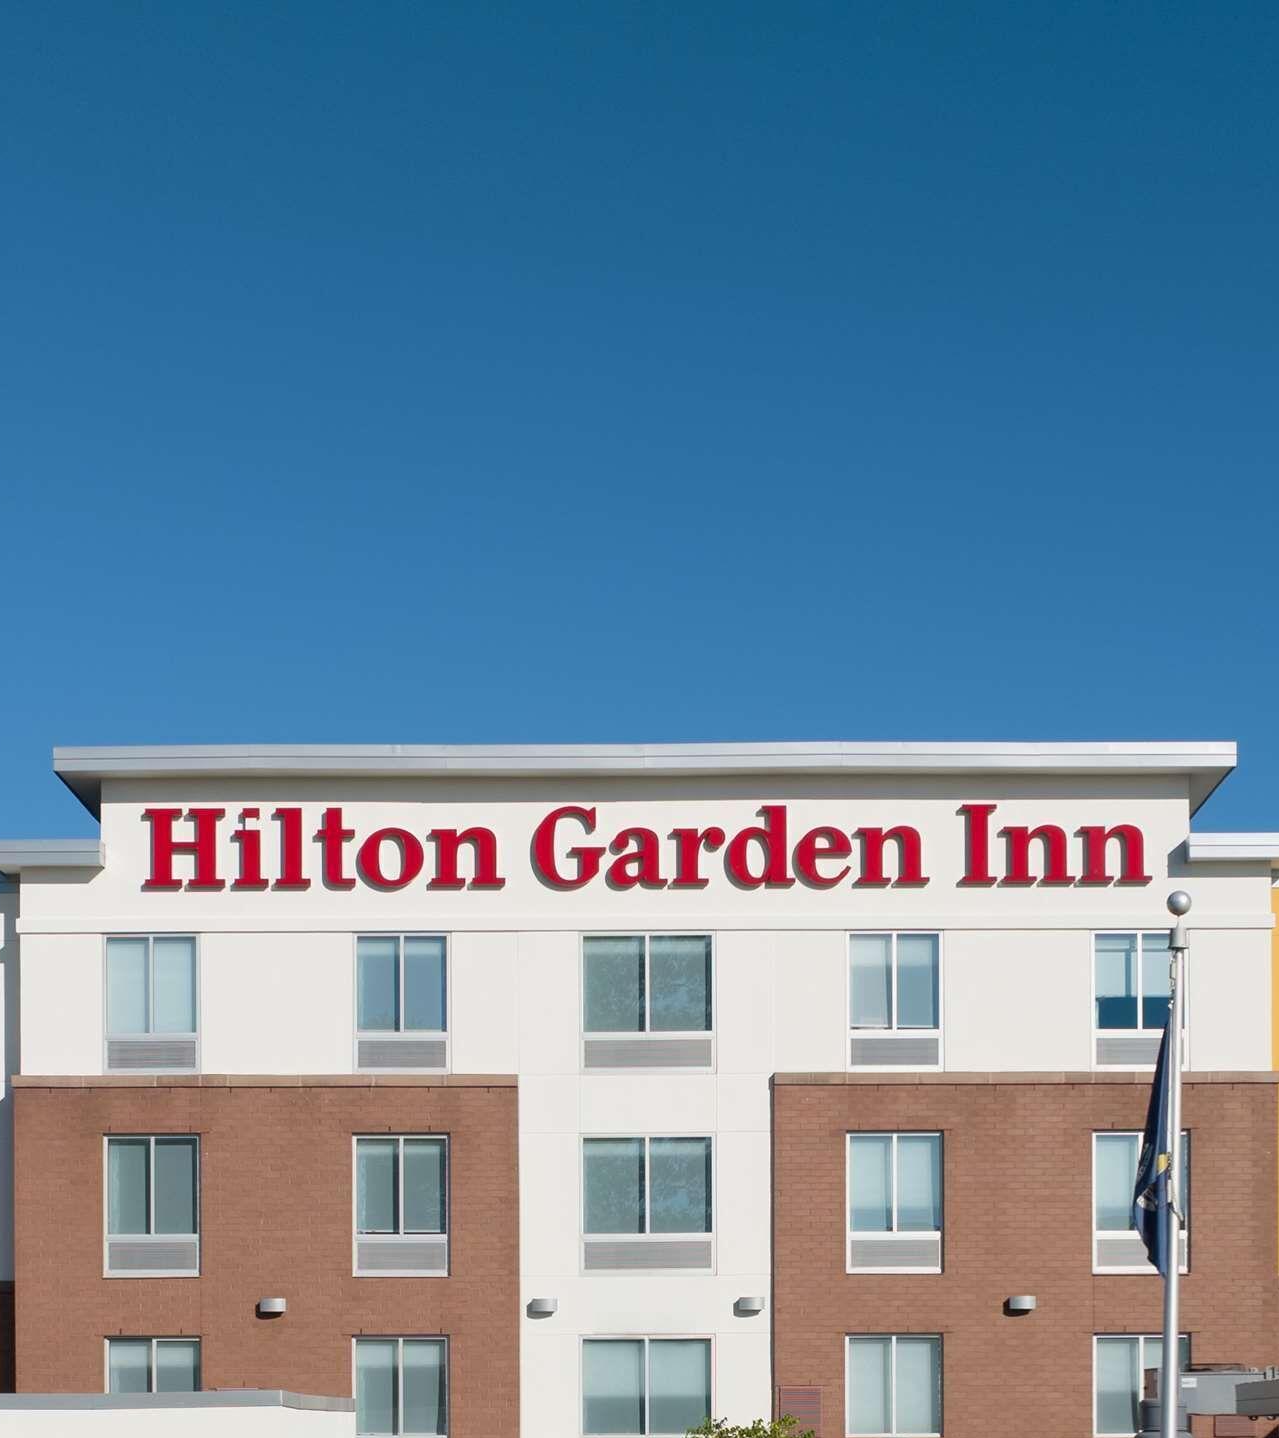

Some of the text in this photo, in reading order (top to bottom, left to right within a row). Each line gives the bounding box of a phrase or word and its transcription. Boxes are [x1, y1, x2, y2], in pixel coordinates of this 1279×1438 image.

[142, 803, 1152, 890] Hilton Garden Inn
